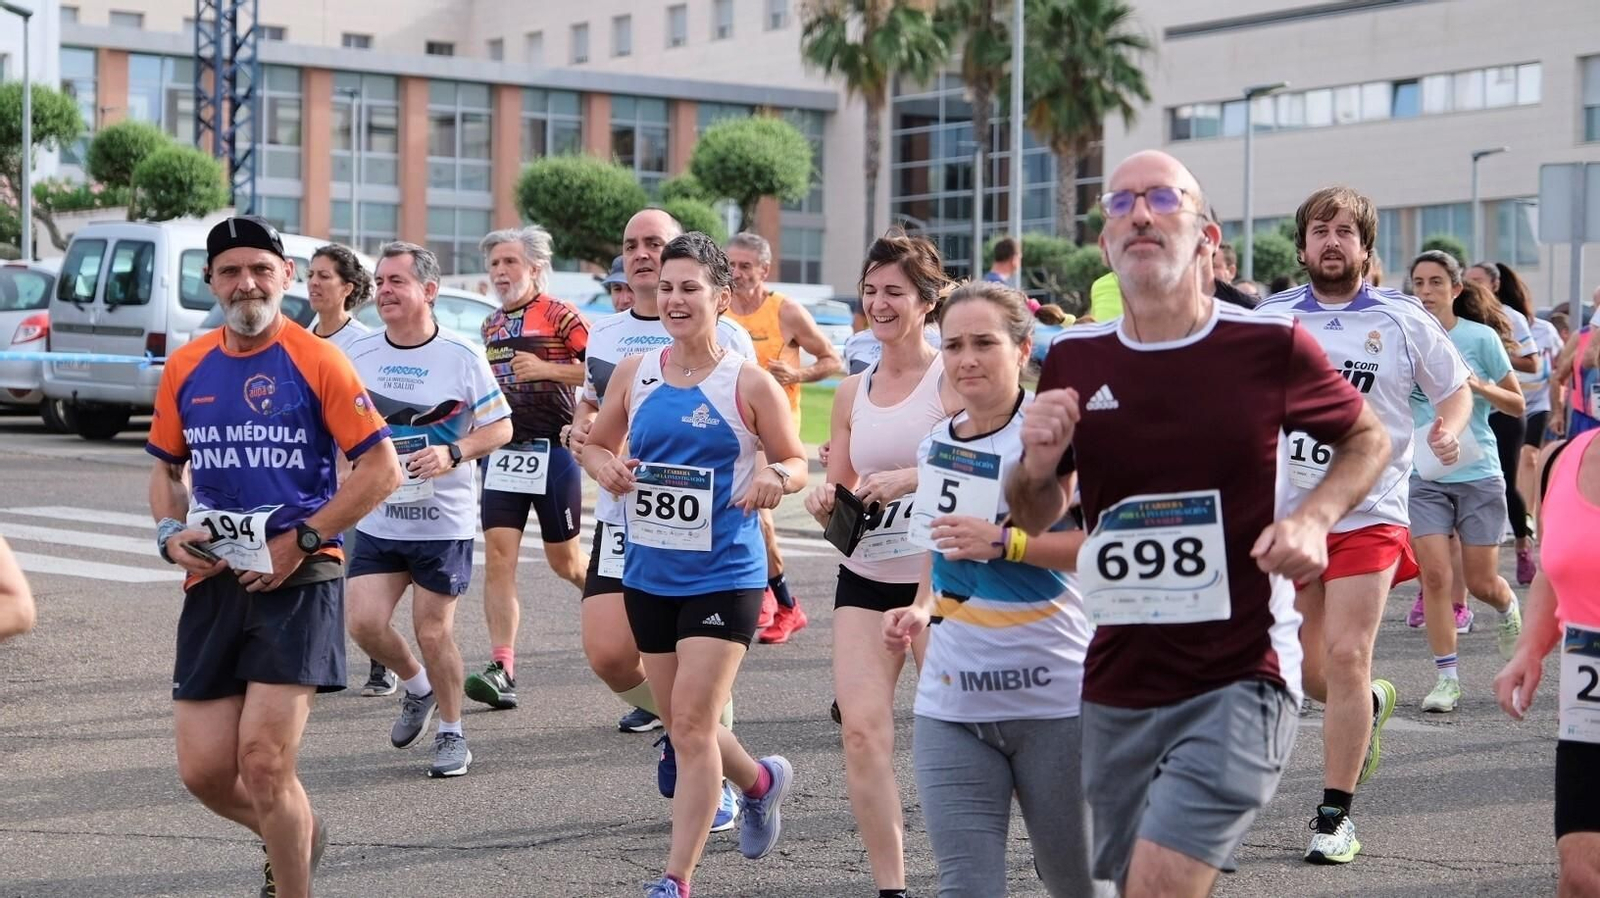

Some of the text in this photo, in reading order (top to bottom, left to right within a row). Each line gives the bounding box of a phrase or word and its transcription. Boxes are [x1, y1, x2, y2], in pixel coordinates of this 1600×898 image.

[383, 366, 429, 378] CARRERA
[1335, 360, 1375, 393] in
[226, 420, 308, 444] MÉDULA
[190, 447, 306, 470] ONA VIDA
[1291, 438, 1330, 464] 16
[496, 455, 540, 474] 429
[636, 490, 700, 522] 580
[938, 479, 960, 513] 5
[385, 505, 440, 520] IMIBIC
[201, 515, 254, 543] 194
[1097, 537, 1206, 581] 698
[960, 666, 1052, 691] IMIBIC
[1577, 665, 1600, 702] 2
